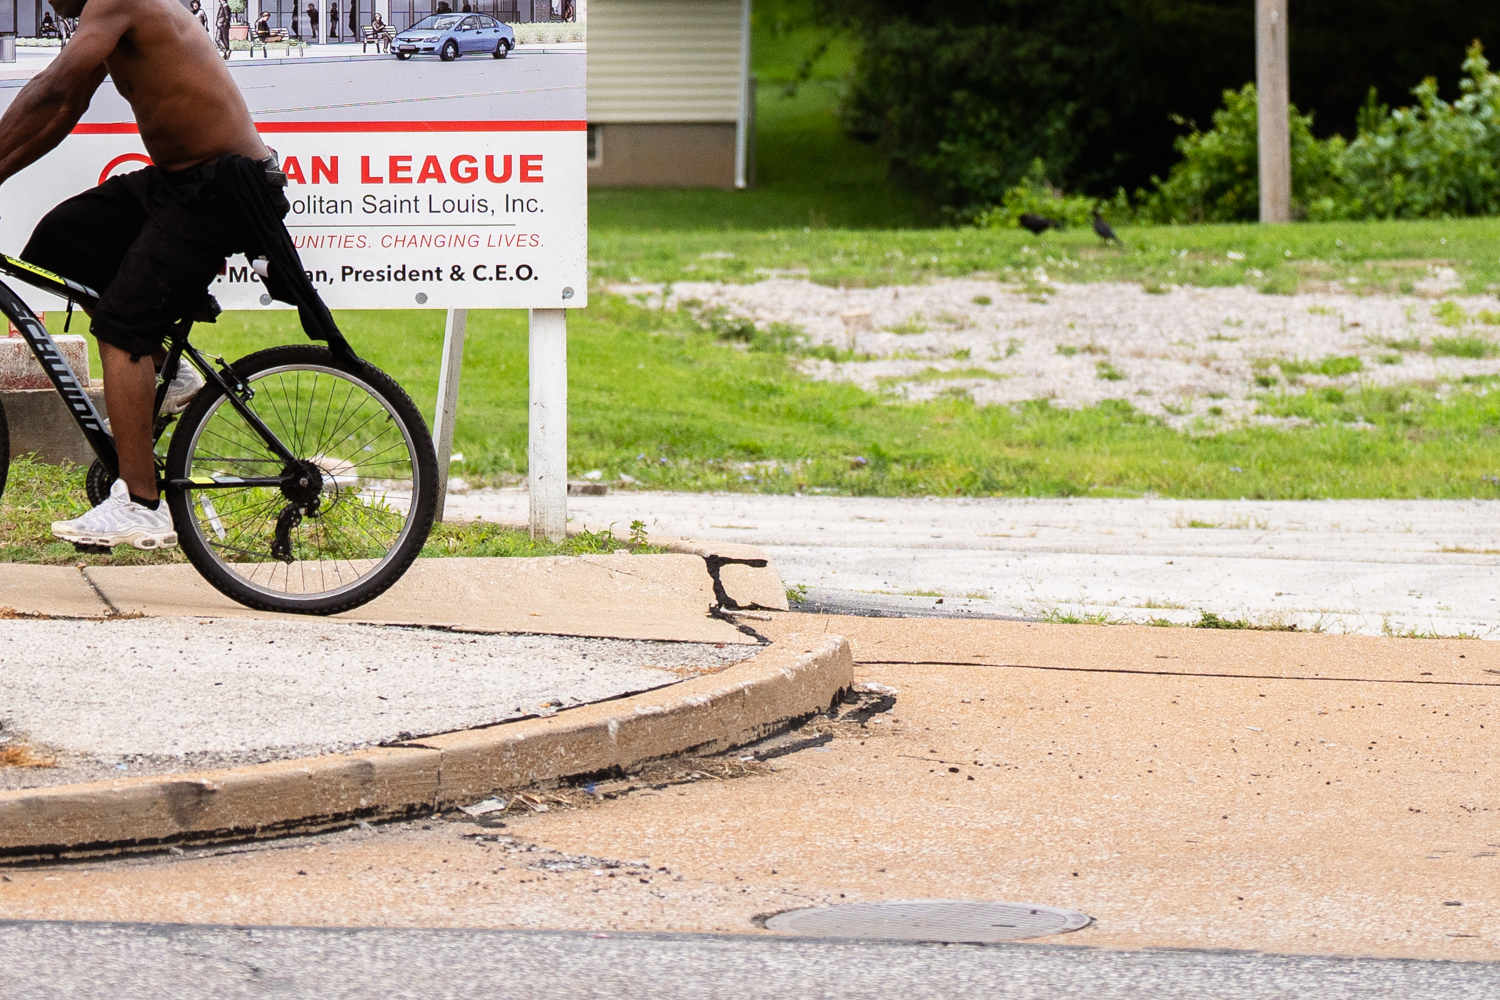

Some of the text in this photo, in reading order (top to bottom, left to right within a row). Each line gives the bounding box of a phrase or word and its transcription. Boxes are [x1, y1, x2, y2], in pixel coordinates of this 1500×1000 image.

[361, 154, 545, 184] LEAGUE
[291, 193, 545, 217] olitan Saint Louis, Inc.
[290, 232, 545, 249] UNITIES. CHANGING LIVES.
[341, 264, 444, 283] President
[449, 265, 467, 282] &
[472, 263, 540, 282] C.E.O.
